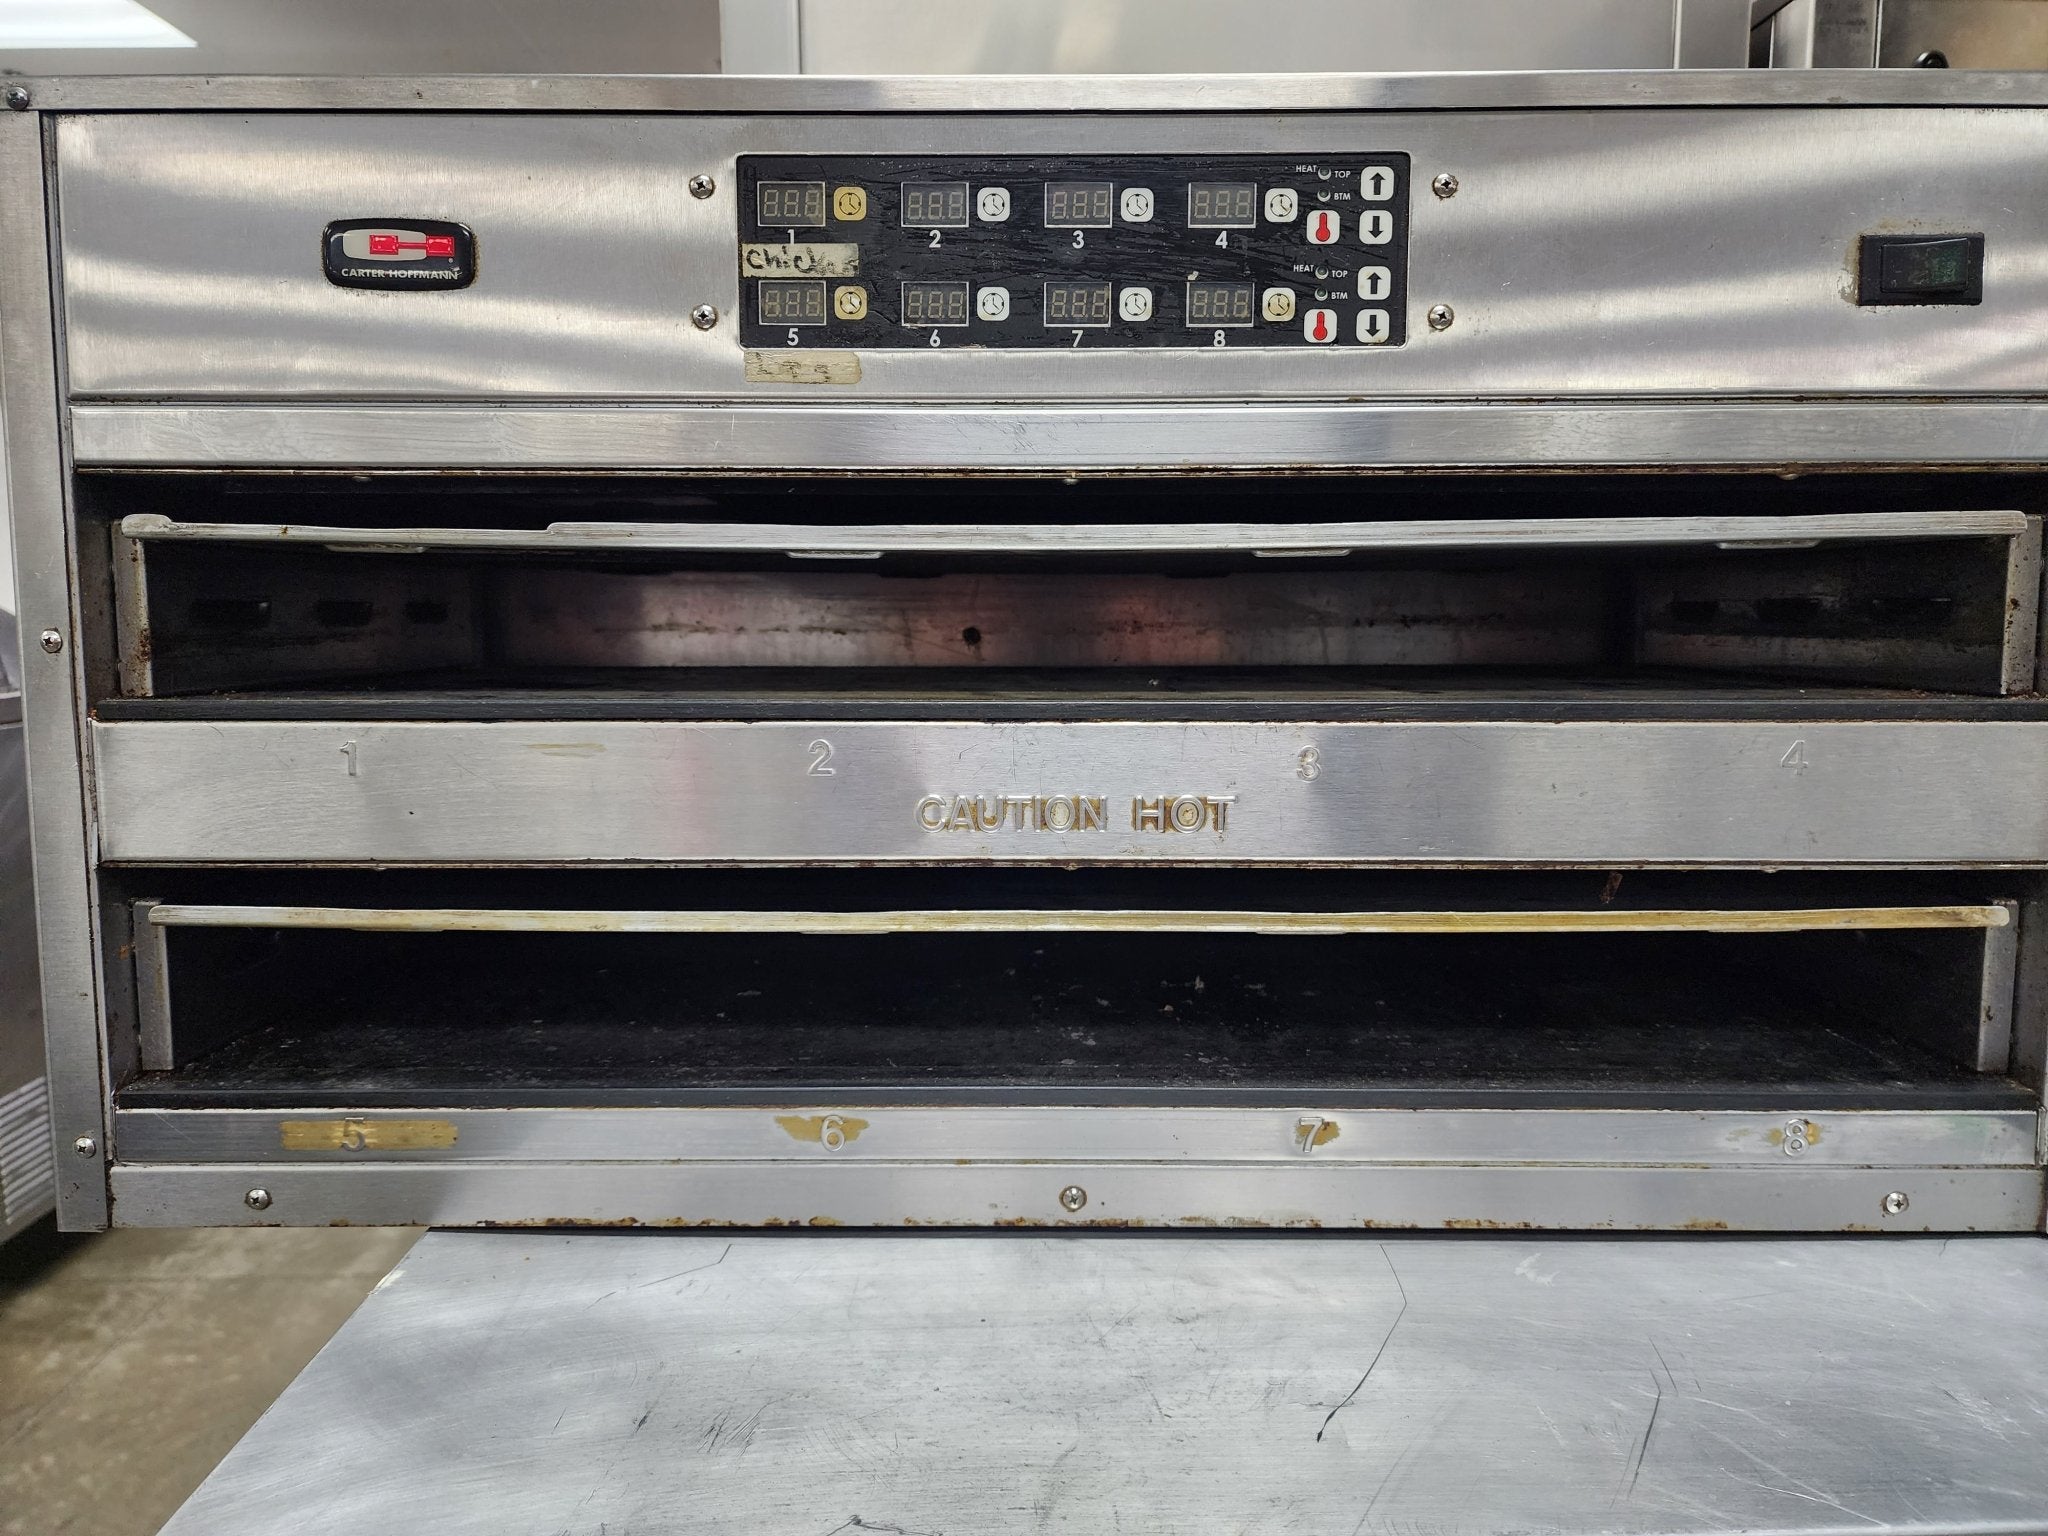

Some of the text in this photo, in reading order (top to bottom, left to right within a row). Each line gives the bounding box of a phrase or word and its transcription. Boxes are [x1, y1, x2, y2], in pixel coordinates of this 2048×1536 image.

[1295, 165, 1317, 173] HEAT
[1334, 170, 1351, 178] TOP
[1333, 192, 1351, 201] BTM
[786, 229, 796, 245] 1
[929, 230, 942, 248] 2
[1072, 230, 1085, 249] 3
[1215, 231, 1228, 249] 4
[1293, 264, 1315, 273] HEAT
[1331, 270, 1348, 278] TOP
[1331, 291, 1348, 300] BTM
[787, 328, 799, 346] 5
[929, 329, 941, 347] 6
[1071, 330, 1084, 348] 7
[1213, 330, 1226, 348] 8
[340, 740, 357, 776] 1
[807, 738, 835, 777] 2
[1297, 745, 1322, 782] 3
[1780, 739, 1808, 776] 4
[915, 793, 1238, 834] CAUTION HOT
[342, 1117, 366, 1151] 5
[821, 1114, 845, 1152] 6
[1299, 1116, 1324, 1153] 7
[1783, 1118, 1809, 1158] 8
